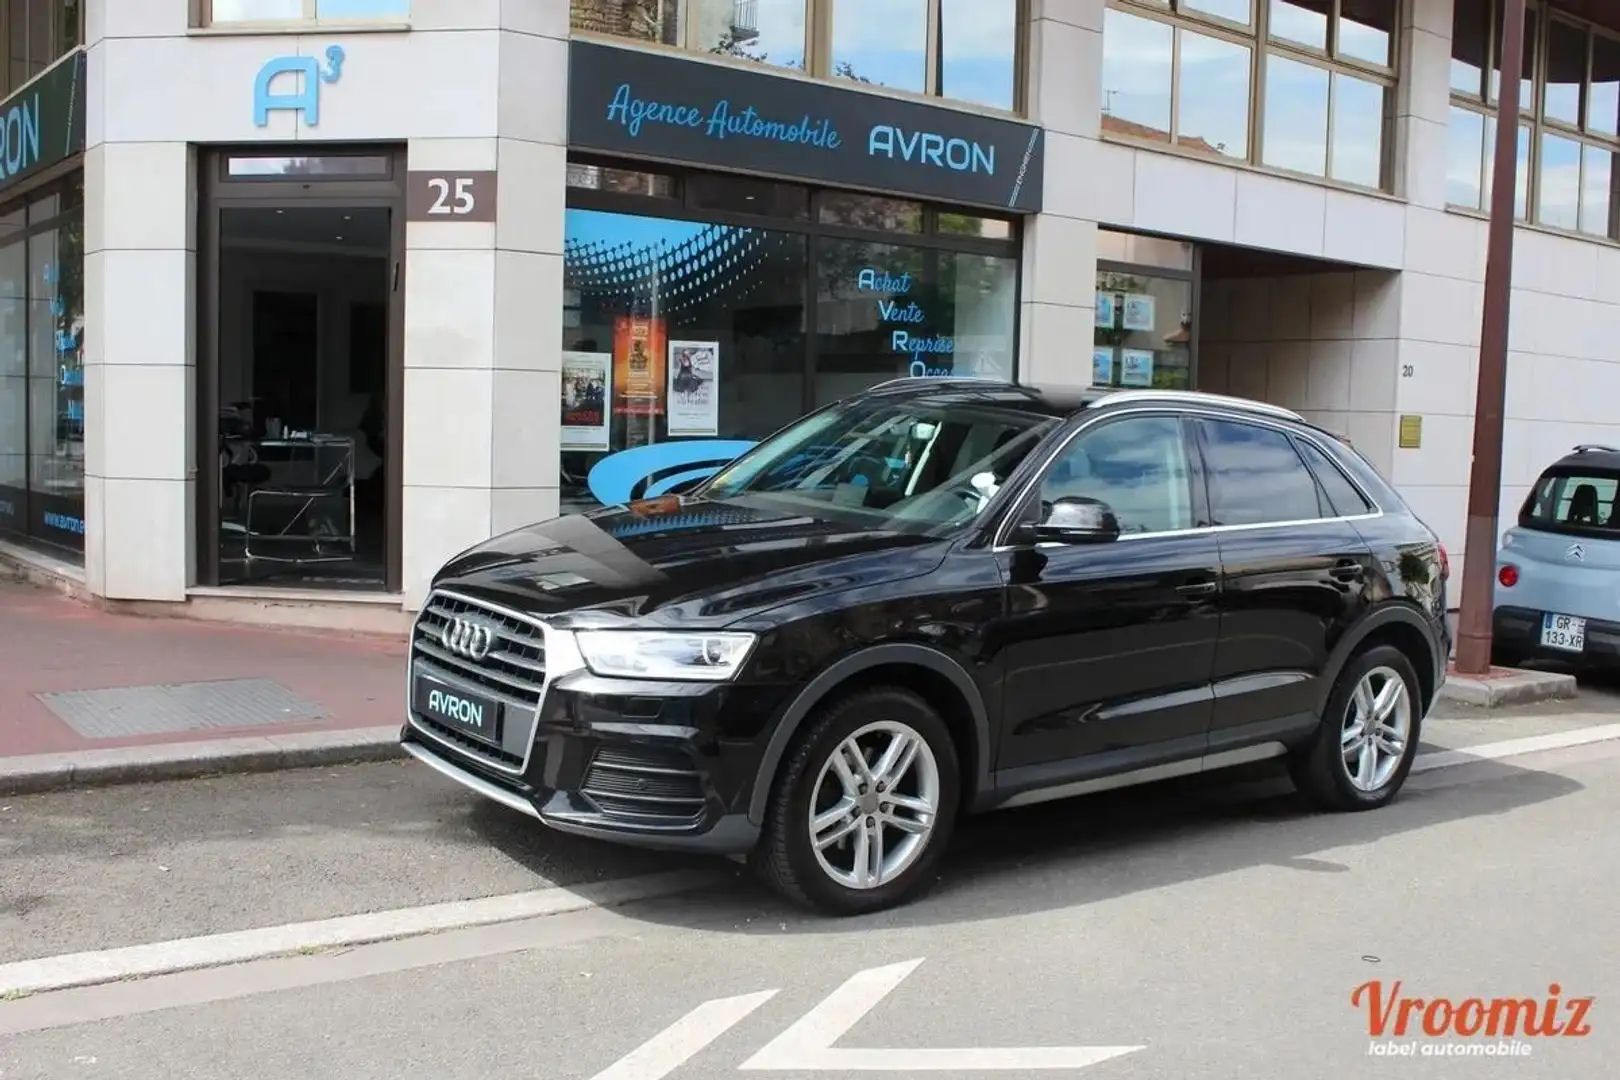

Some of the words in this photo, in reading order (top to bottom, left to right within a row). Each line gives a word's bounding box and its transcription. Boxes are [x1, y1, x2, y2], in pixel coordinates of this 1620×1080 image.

[607, 84, 702, 137] Agence
[706, 100, 842, 149] Automobile
[869, 125, 995, 176] AVRON
[427, 178, 475, 214] 25
[858, 269, 911, 293] Achat
[878, 300, 925, 323] Vente
[892, 330, 954, 361] Reprise
[1402, 364, 1414, 377] 20
[1546, 630, 1583, 648] 133-XR
[429, 689, 482, 727] AVRON
